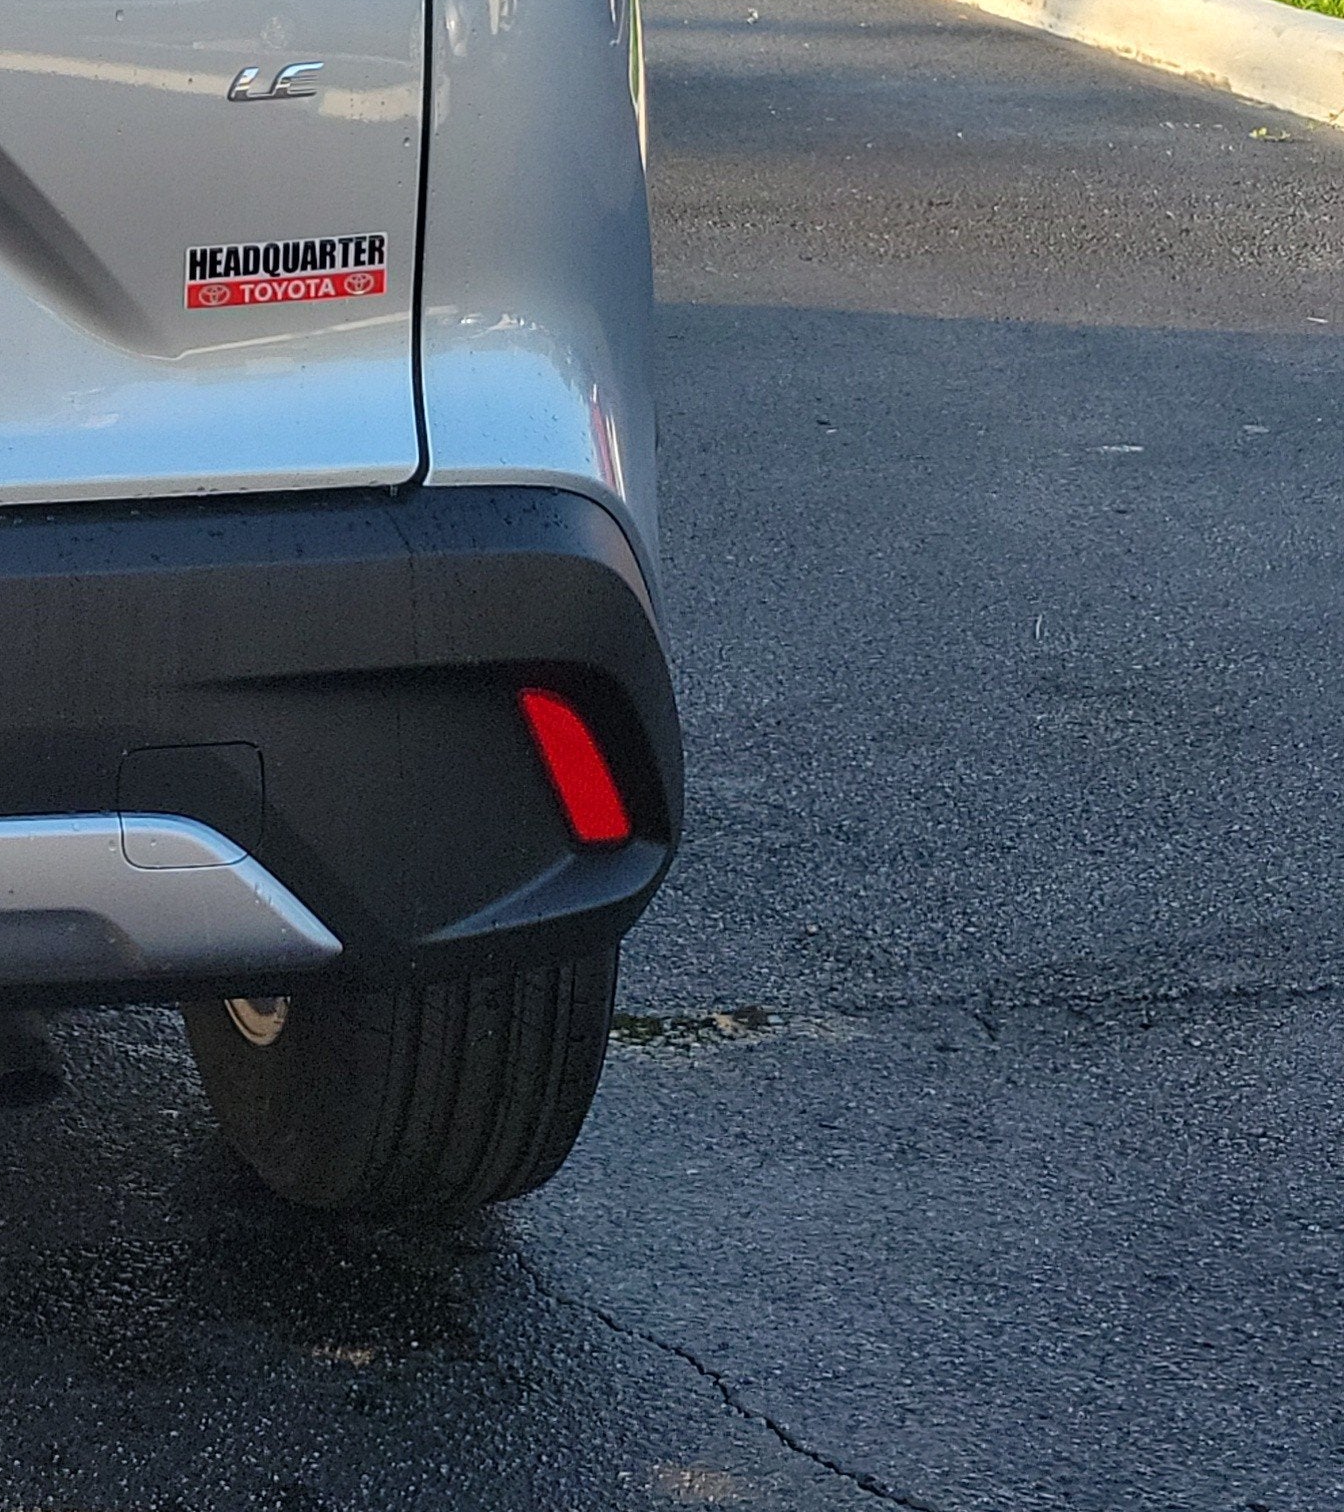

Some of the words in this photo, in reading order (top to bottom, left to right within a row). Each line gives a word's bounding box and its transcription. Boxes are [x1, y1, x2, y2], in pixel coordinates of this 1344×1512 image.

[227, 61, 325, 102] LE
[188, 234, 386, 282] HEADQUARTER
[239, 278, 337, 304] TOYOTA
